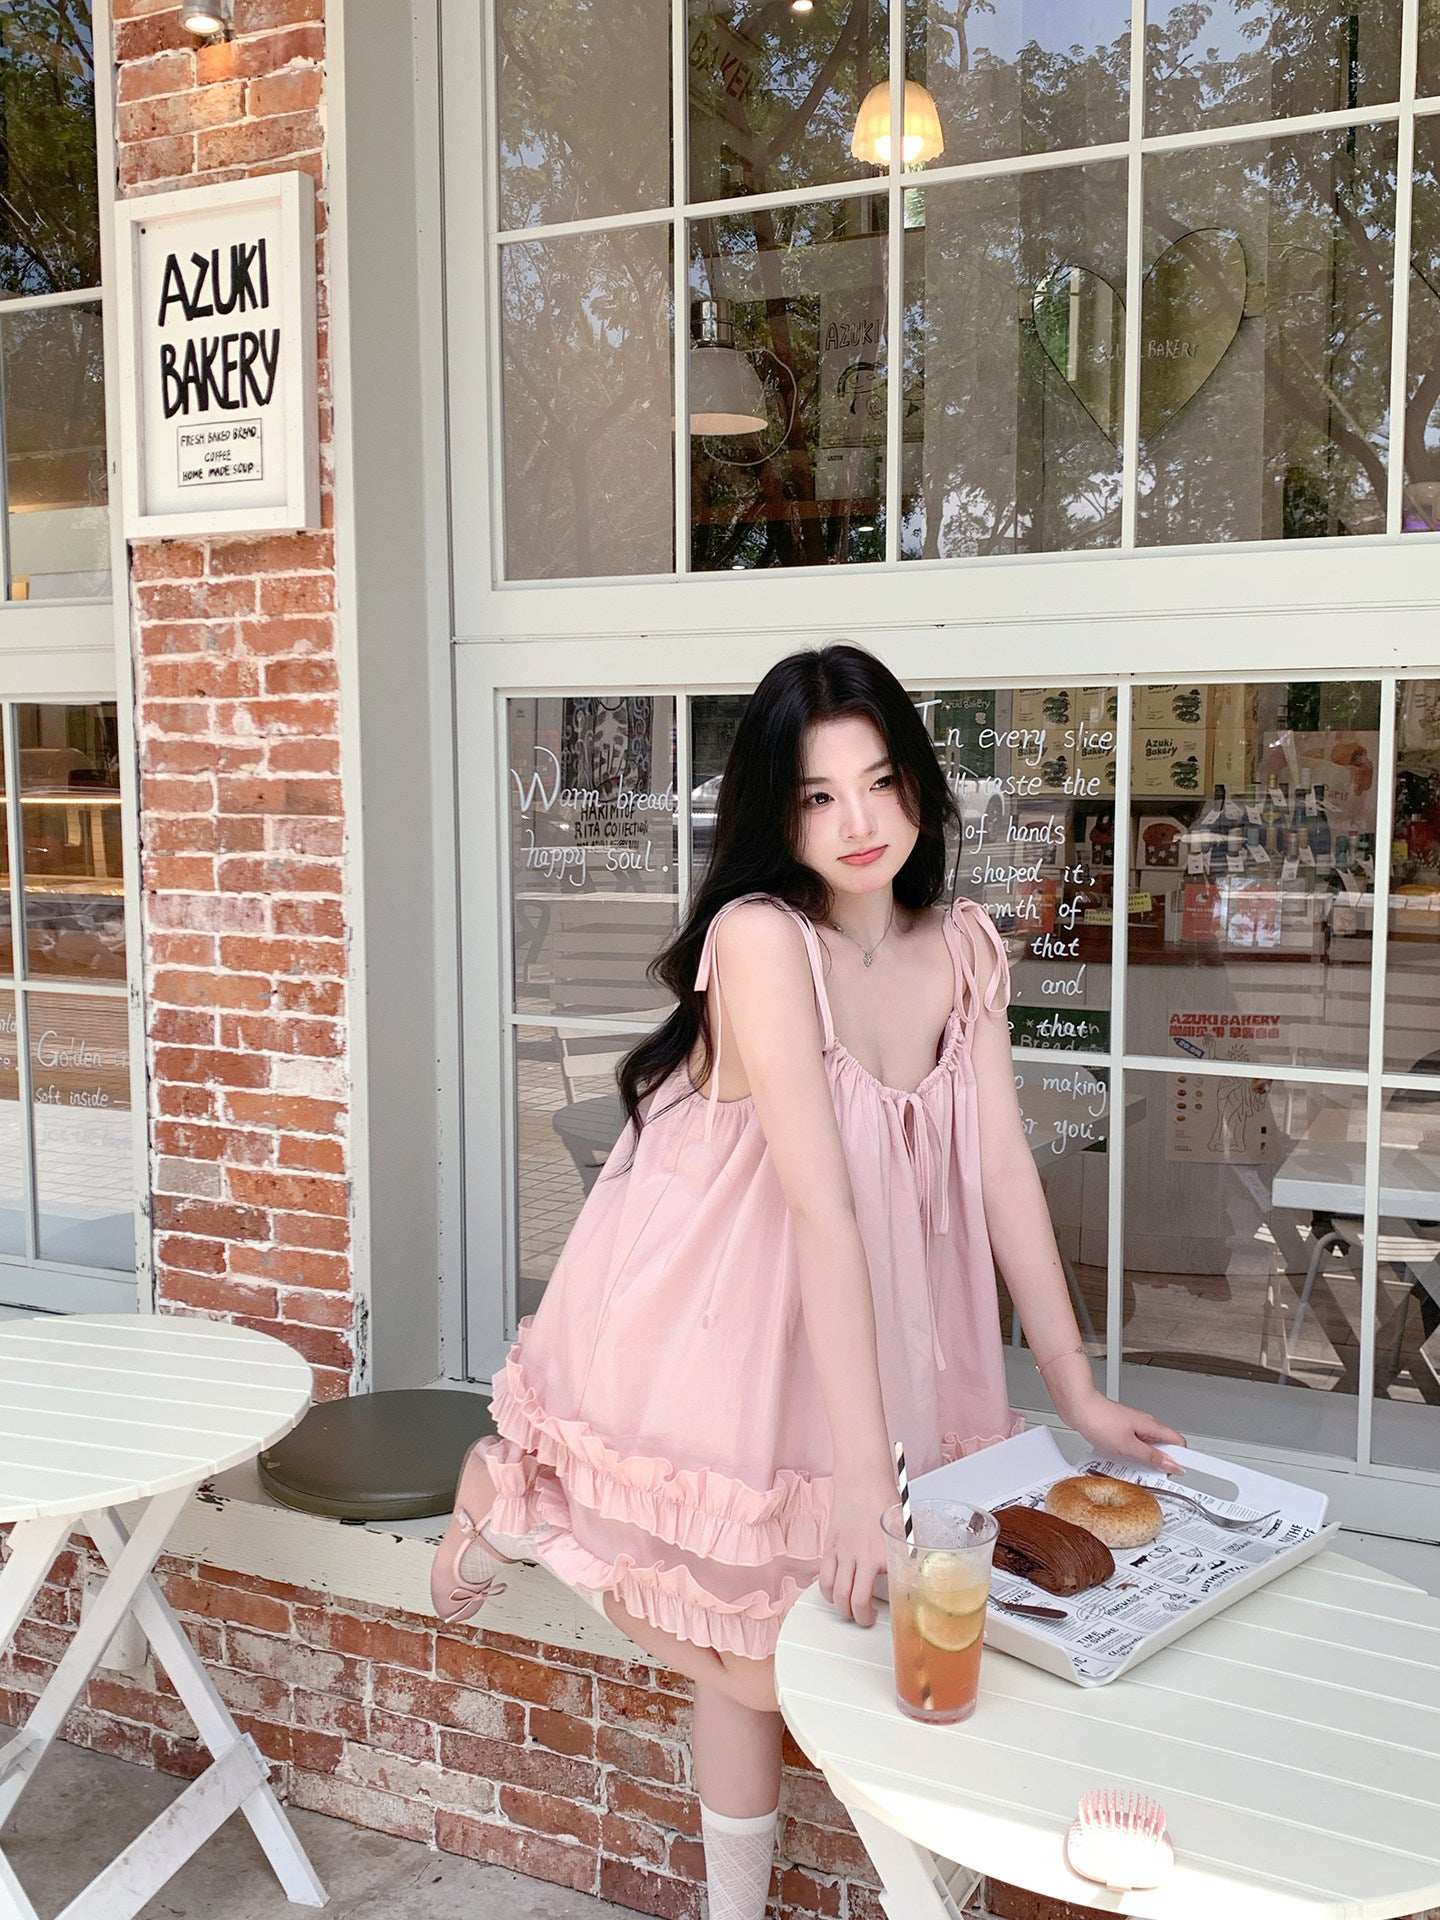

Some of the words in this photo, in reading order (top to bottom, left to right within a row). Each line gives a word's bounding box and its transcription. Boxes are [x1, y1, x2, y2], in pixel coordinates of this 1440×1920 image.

[157, 238, 269, 327] AZUKI
[825, 319, 880, 350] AZUKI
[160, 328, 281, 419] BAKERY
[181, 434, 205, 447] FRESH
[208, 430, 231, 443] BAKED
[204, 449, 231, 463] COFFEE
[183, 468, 204, 482] HOME
[208, 465, 230, 477] MADE
[979, 728, 1047, 767] every
[1064, 721, 1117, 752] slice,
[1145, 739, 1174, 750] Azuki
[1145, 747, 1178, 758] Bakery
[510, 746, 600, 812] Warm
[984, 775, 1043, 796] taste
[1062, 768, 1101, 796] the
[574, 821, 600, 839] RITA
[965, 814, 989, 854] of
[1006, 814, 1066, 845] hands
[525, 829, 587, 887] happy
[970, 856, 1043, 894] shaped
[1063, 864, 1096, 887] it,
[1058, 895, 1084, 931] of
[1030, 932, 1080, 959] that
[1041, 963, 1087, 996] and
[1035, 1013, 1088, 1037] that
[37, 1030, 103, 1069] Golden
[69, 1086, 109, 1108] inside
[1042, 1071, 1107, 1117] making
[1051, 1120, 1105, 1155] you.
[1076, 1630, 1099, 1645] TIME
[1090, 1627, 1119, 1645] SHARE
